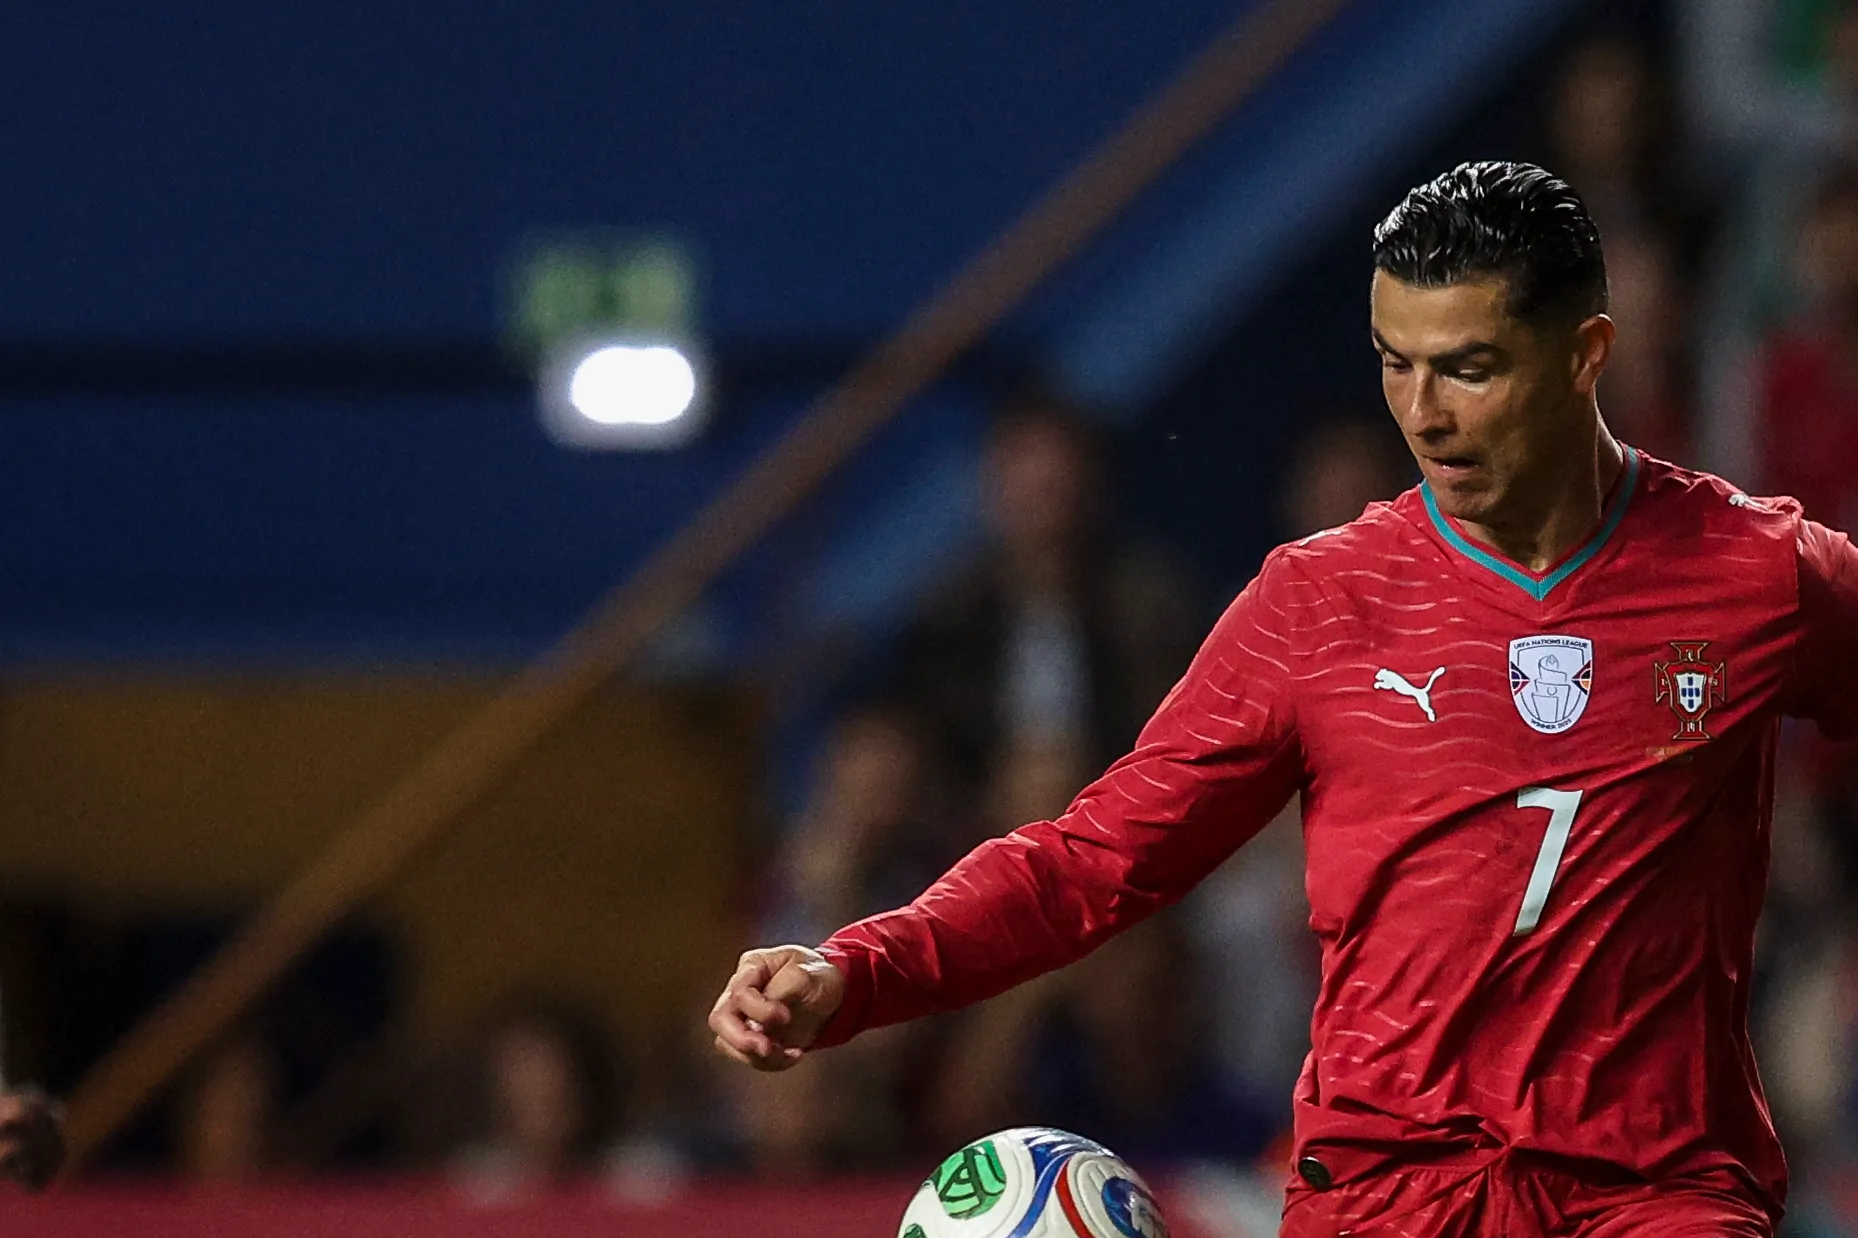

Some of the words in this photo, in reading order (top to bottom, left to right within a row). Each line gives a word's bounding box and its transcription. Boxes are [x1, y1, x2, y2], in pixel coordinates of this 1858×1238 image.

[1514, 641, 1530, 649] UEFA
[1531, 638, 1561, 646] NATIONS
[1562, 639, 1589, 649] LEAGUE
[1513, 786, 1584, 937] 7
